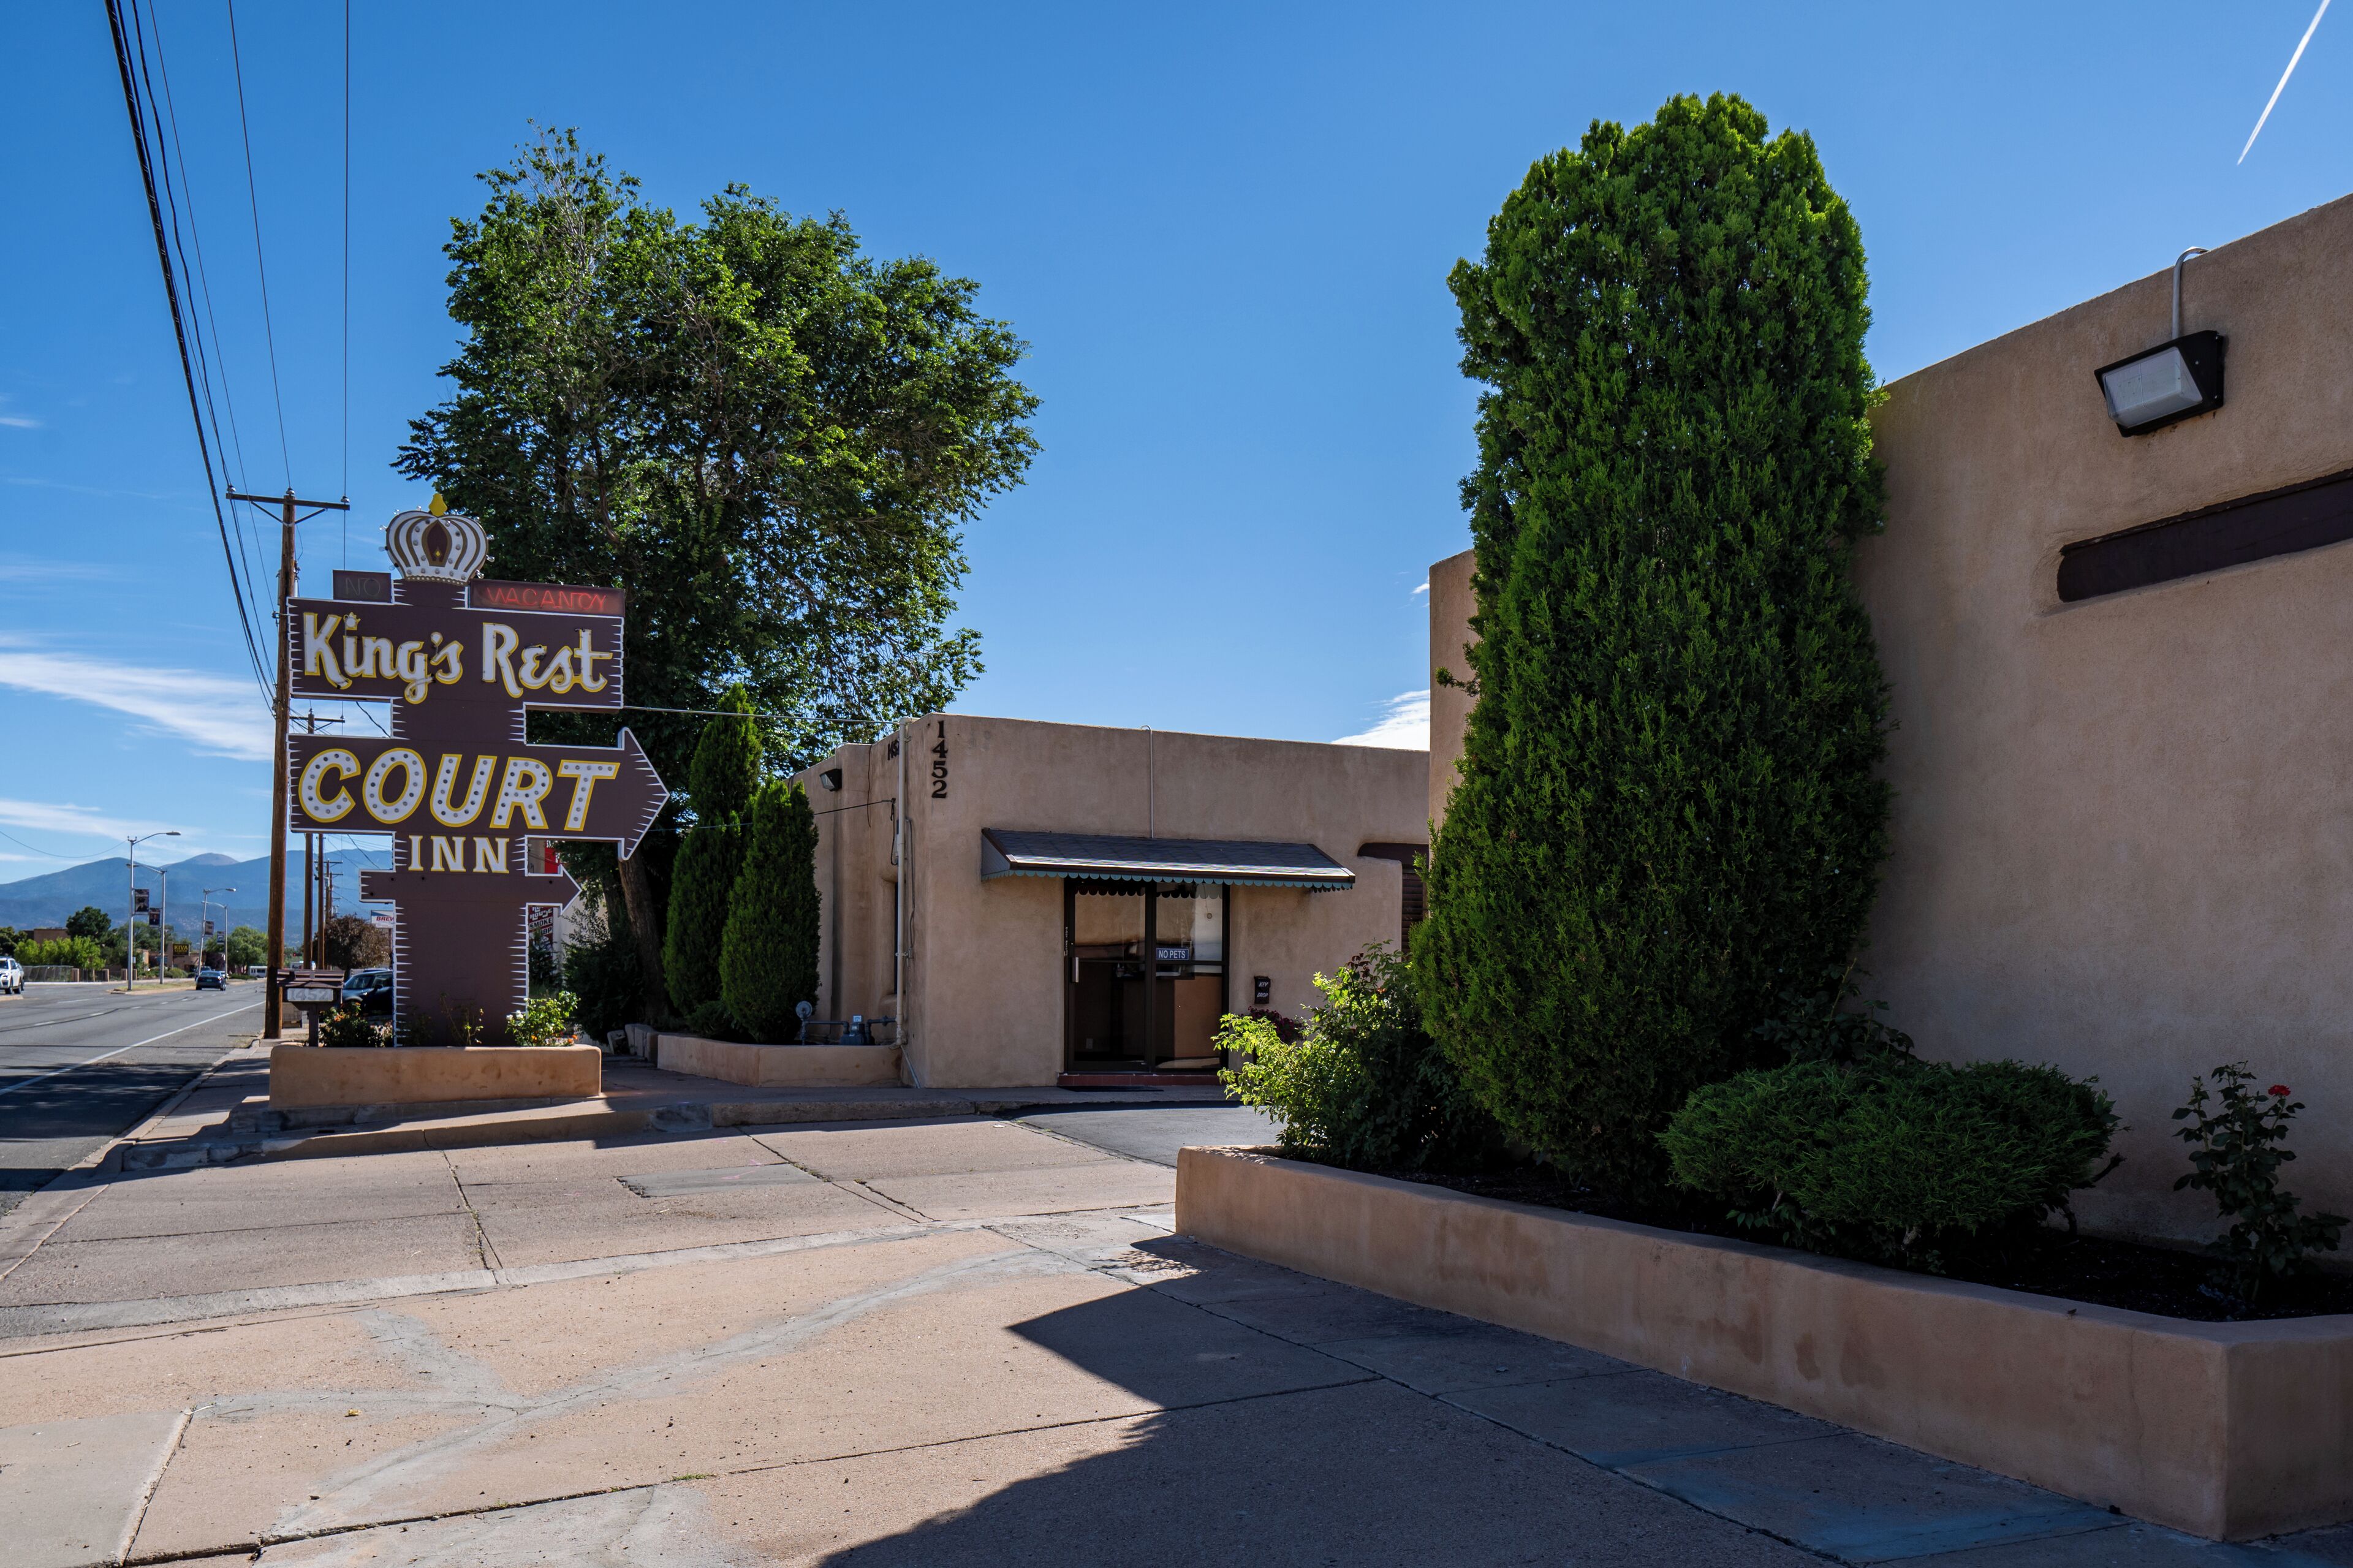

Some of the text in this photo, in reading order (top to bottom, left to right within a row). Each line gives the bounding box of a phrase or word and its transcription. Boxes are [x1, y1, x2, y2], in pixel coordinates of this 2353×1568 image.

[345, 577, 606, 610] NO VACANCY
[303, 612, 613, 705] King's Rest
[931, 720, 949, 799] 1452
[298, 748, 620, 831] COURT
[408, 835, 510, 874] INN
[529, 917, 553, 929] SMOKE
[1159, 950, 1186, 959] NO PETS
[291, 988, 329, 1001] 1452
